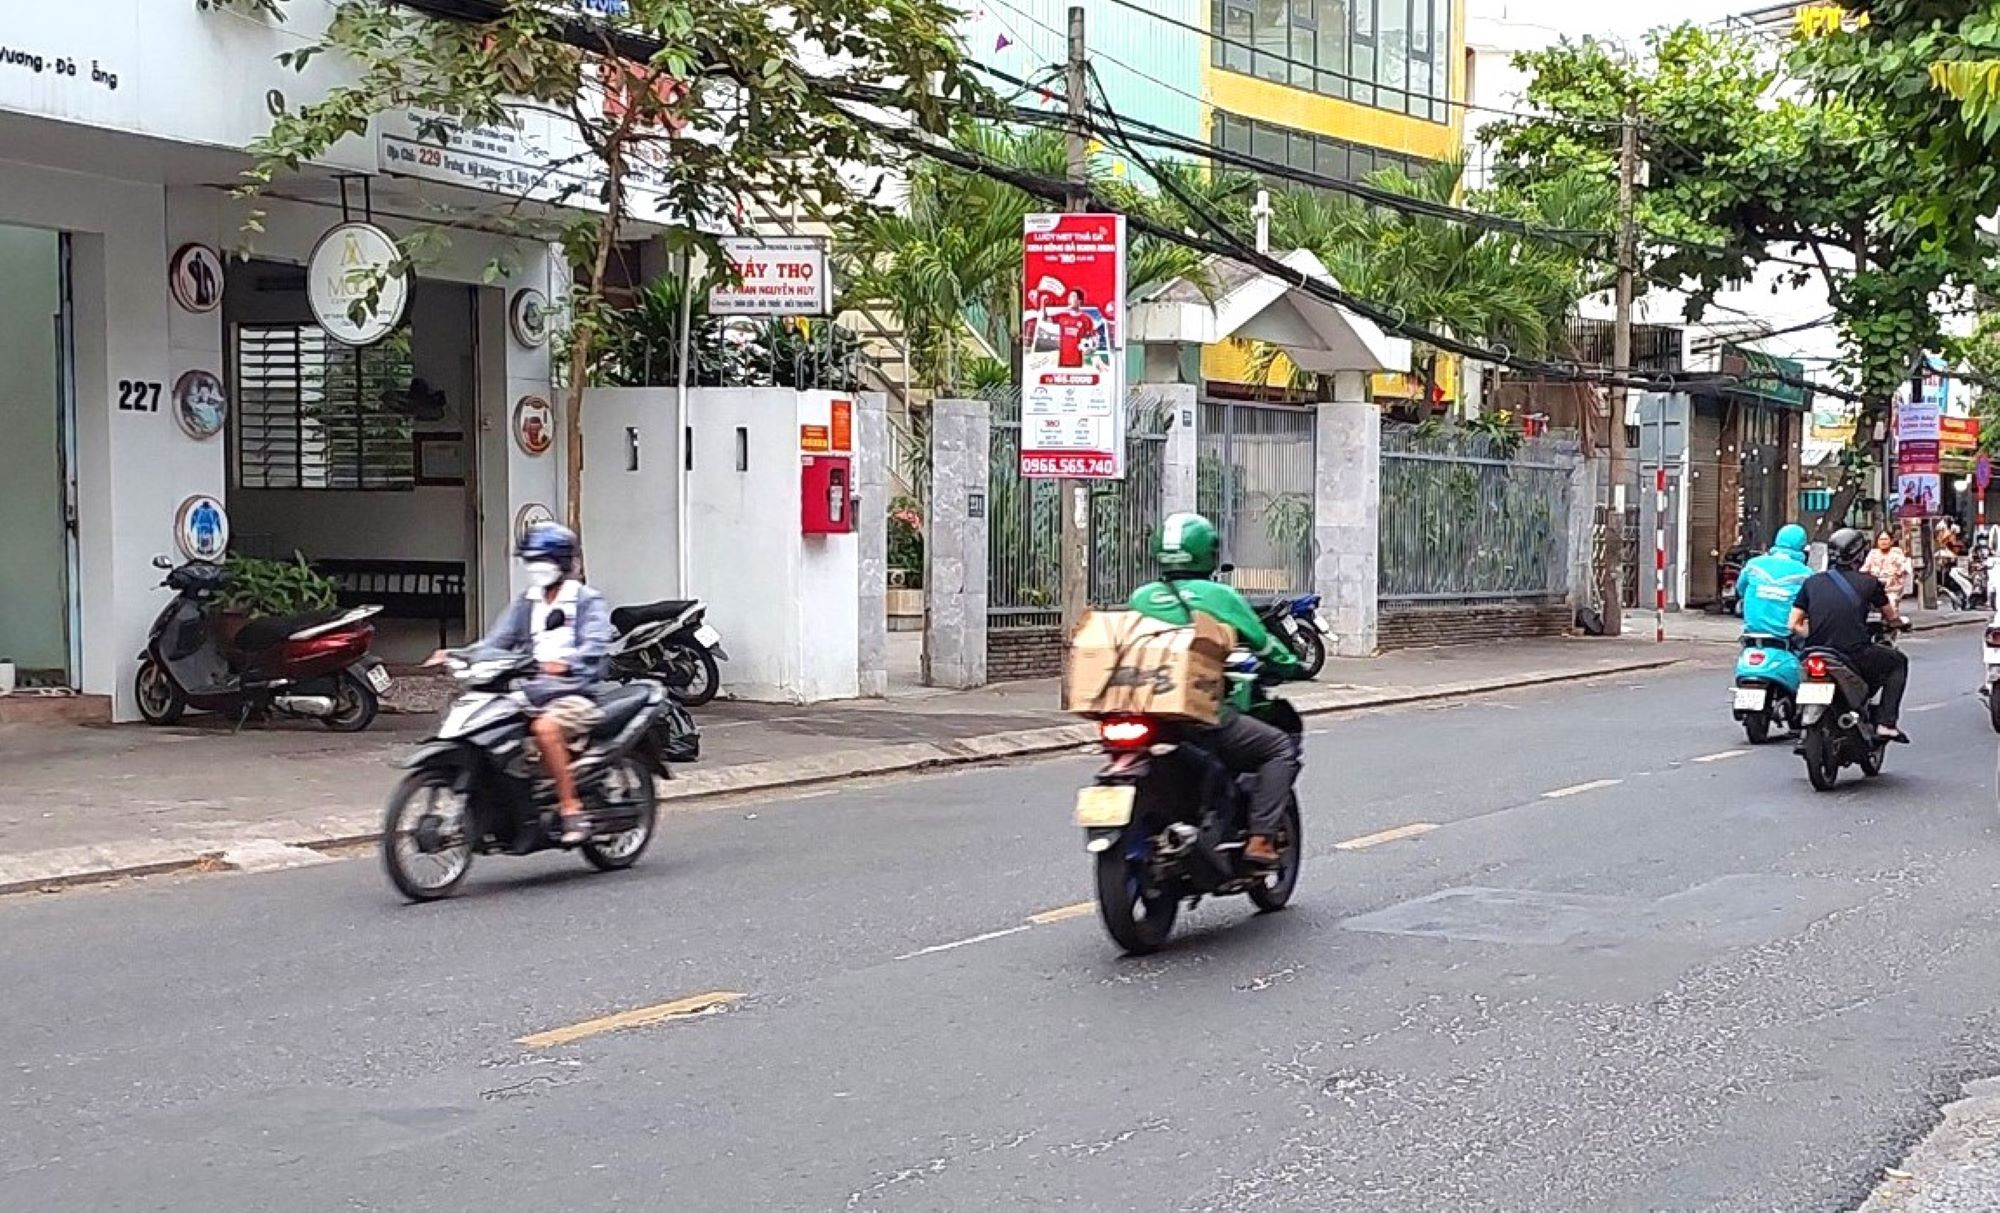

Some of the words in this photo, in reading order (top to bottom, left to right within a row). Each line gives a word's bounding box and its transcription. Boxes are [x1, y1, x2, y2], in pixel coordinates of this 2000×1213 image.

[56, 57, 76, 76] Đà
[418, 148, 441, 168] 229
[776, 263, 814, 282] THỌ
[757, 282, 795, 296] NGUYỄN
[796, 285, 816, 296] HUY
[118, 379, 162, 413] 227
[1021, 456, 1114, 474] 0966.565.740
